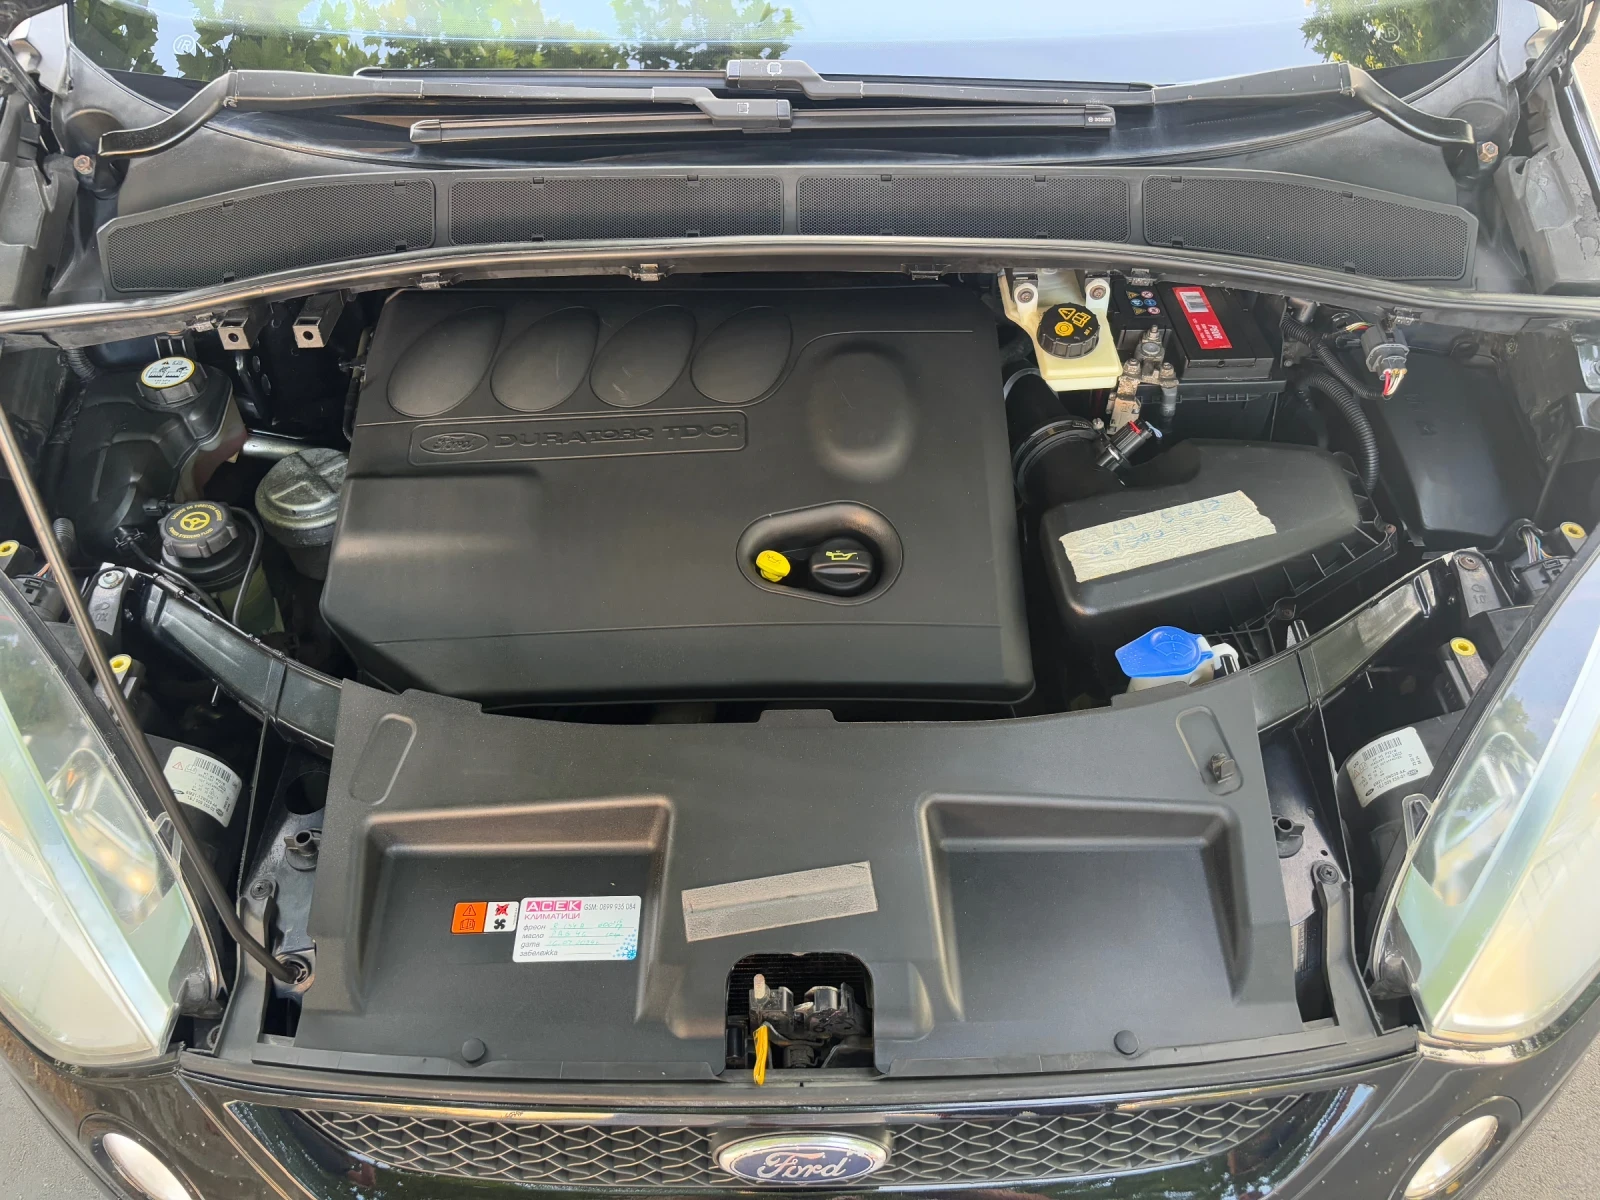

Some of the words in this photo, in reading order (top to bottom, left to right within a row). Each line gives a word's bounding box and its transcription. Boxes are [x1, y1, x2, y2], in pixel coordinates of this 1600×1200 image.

[495, 424, 654, 448] DURATORQ
[432, 432, 475, 452] Ford
[584, 903, 598, 911] GSM:
[524, 912, 580, 920] КЛИМАТИЦИ
[522, 924, 546, 932] фреон
[519, 949, 559, 957] забележка
[756, 1151, 849, 1178] Ford
